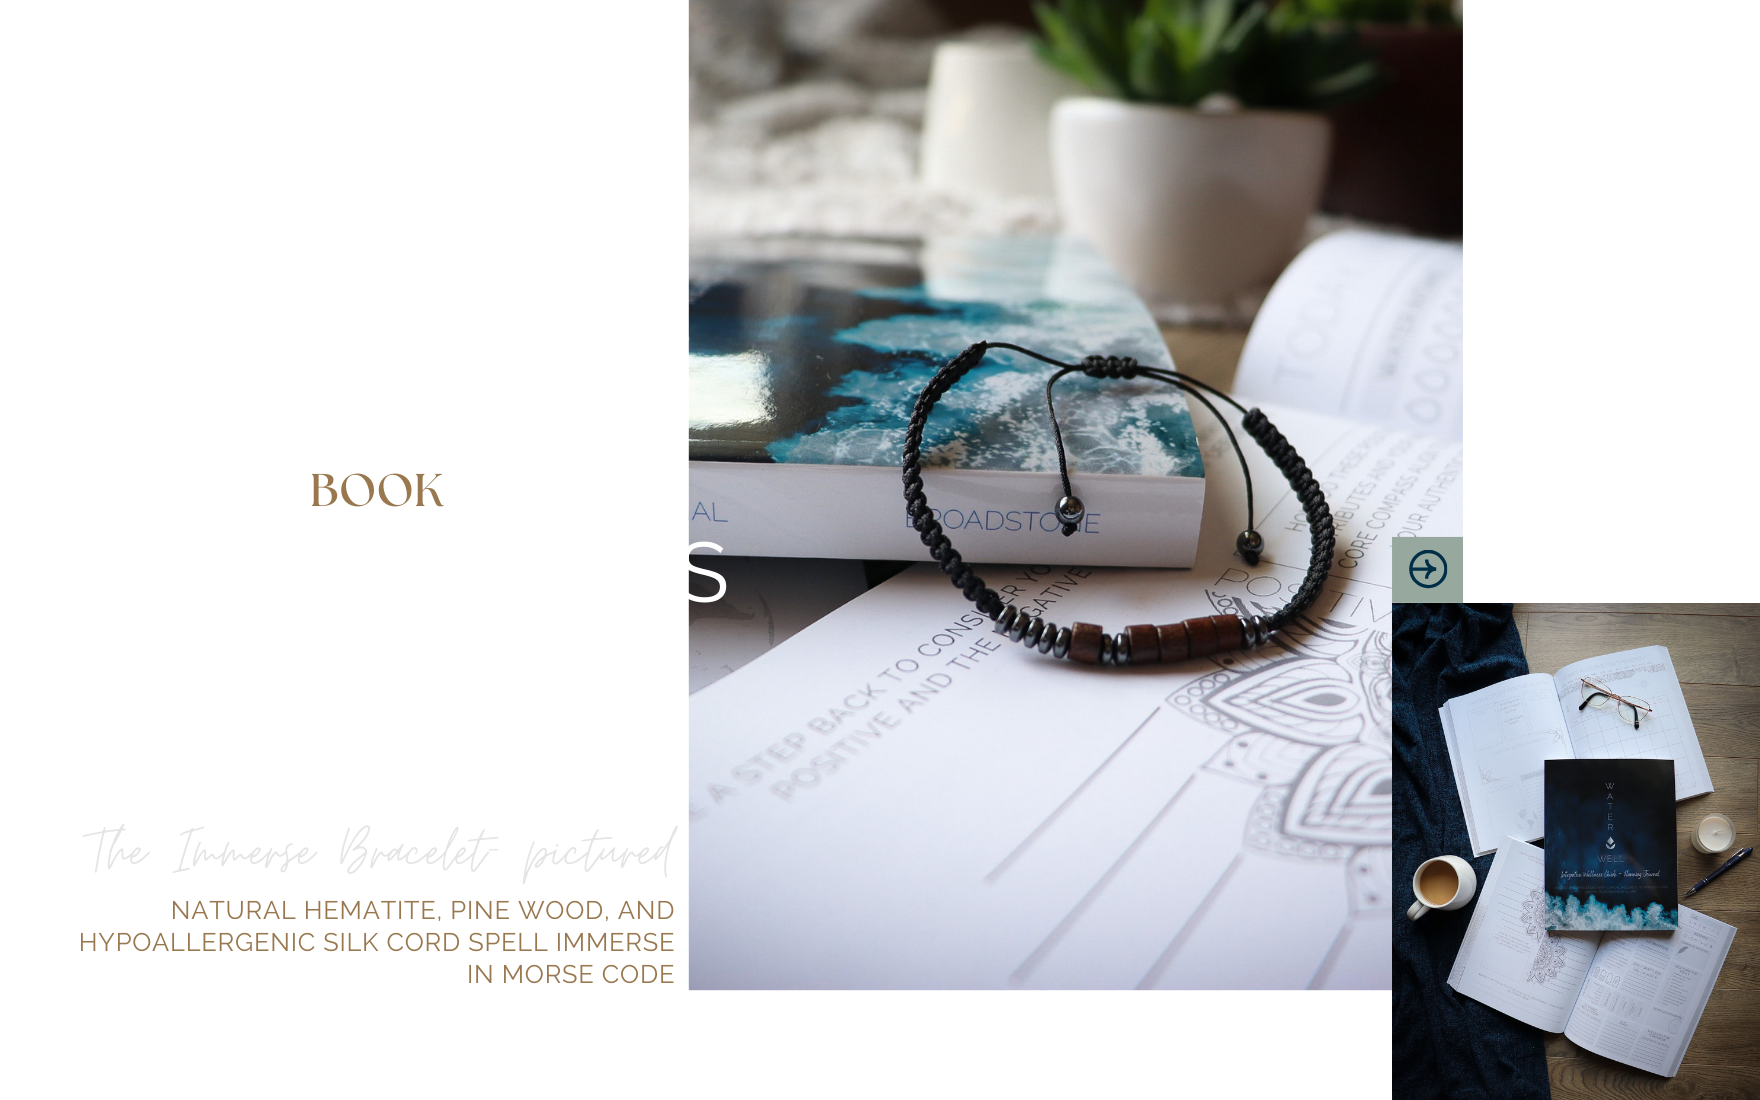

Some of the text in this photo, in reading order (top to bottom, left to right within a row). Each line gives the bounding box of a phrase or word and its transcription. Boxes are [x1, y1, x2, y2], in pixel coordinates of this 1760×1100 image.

[688, 501, 728, 522] AL
[1284, 510, 1307, 532] HO
[1338, 531, 1378, 568] CORE
[1366, 474, 1419, 530] COMPASS
[731, 731, 807, 786] STEP
[807, 682, 888, 737] BACK
[877, 658, 919, 684] TO
[918, 584, 1026, 657] CONSIER
[769, 710, 901, 802] POSITIVE
[898, 672, 953, 715] AND
[945, 637, 1002, 670] THE
[1604, 782, 1616, 831] WATER
[1597, 854, 1625, 863] WELL
